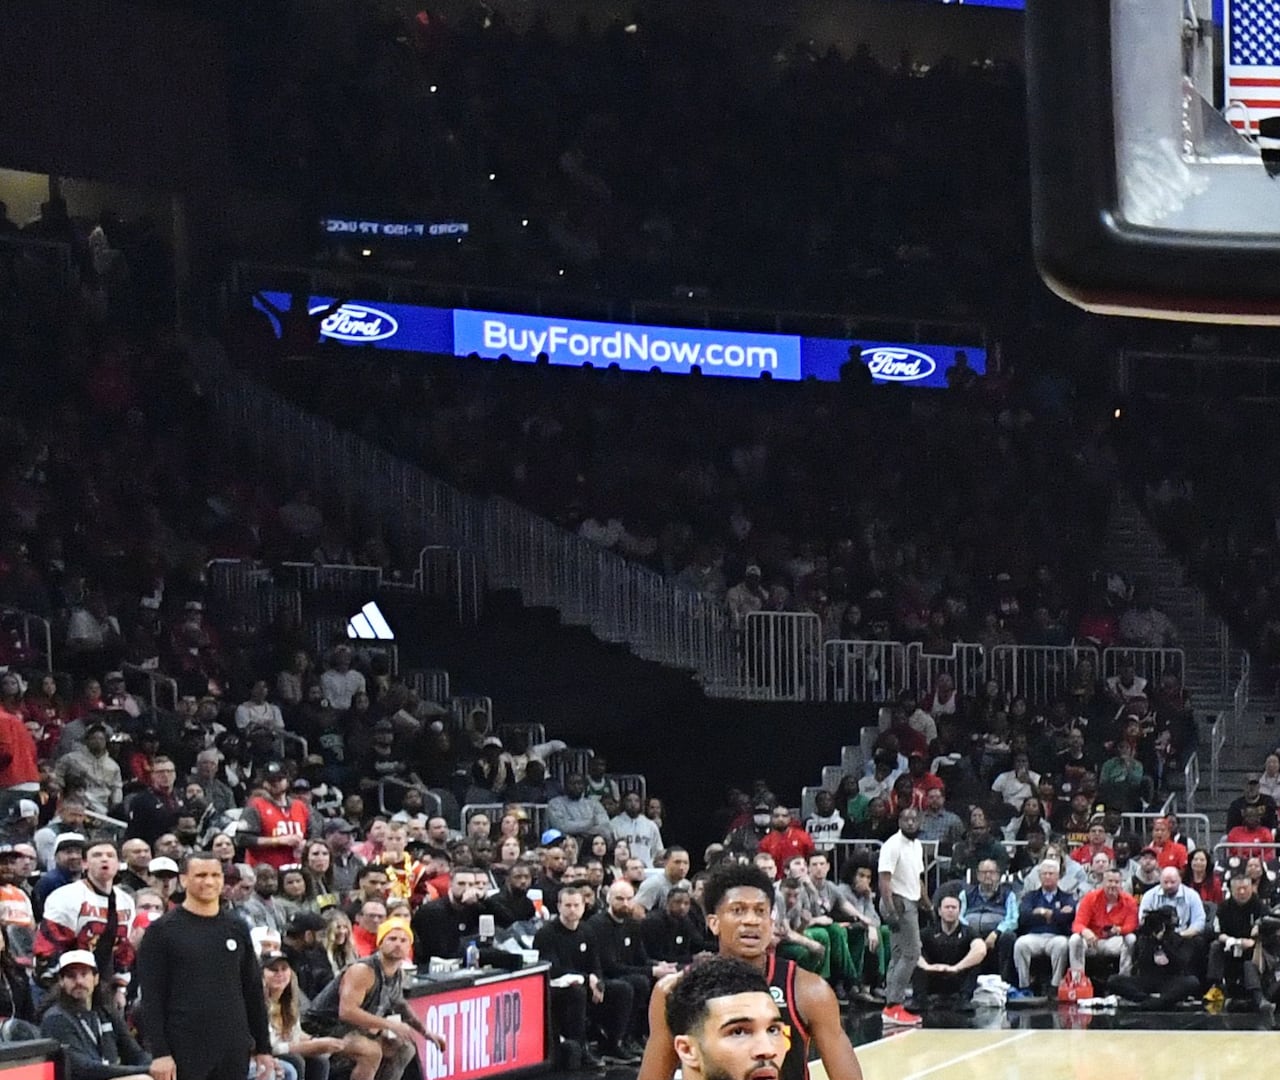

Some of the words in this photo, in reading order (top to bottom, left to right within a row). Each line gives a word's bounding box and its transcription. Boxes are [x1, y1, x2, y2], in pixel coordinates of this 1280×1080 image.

[483, 320, 778, 369] BuyFordNow.com
[459, 994, 492, 1073] THE
[492, 988, 522, 1066] APP
